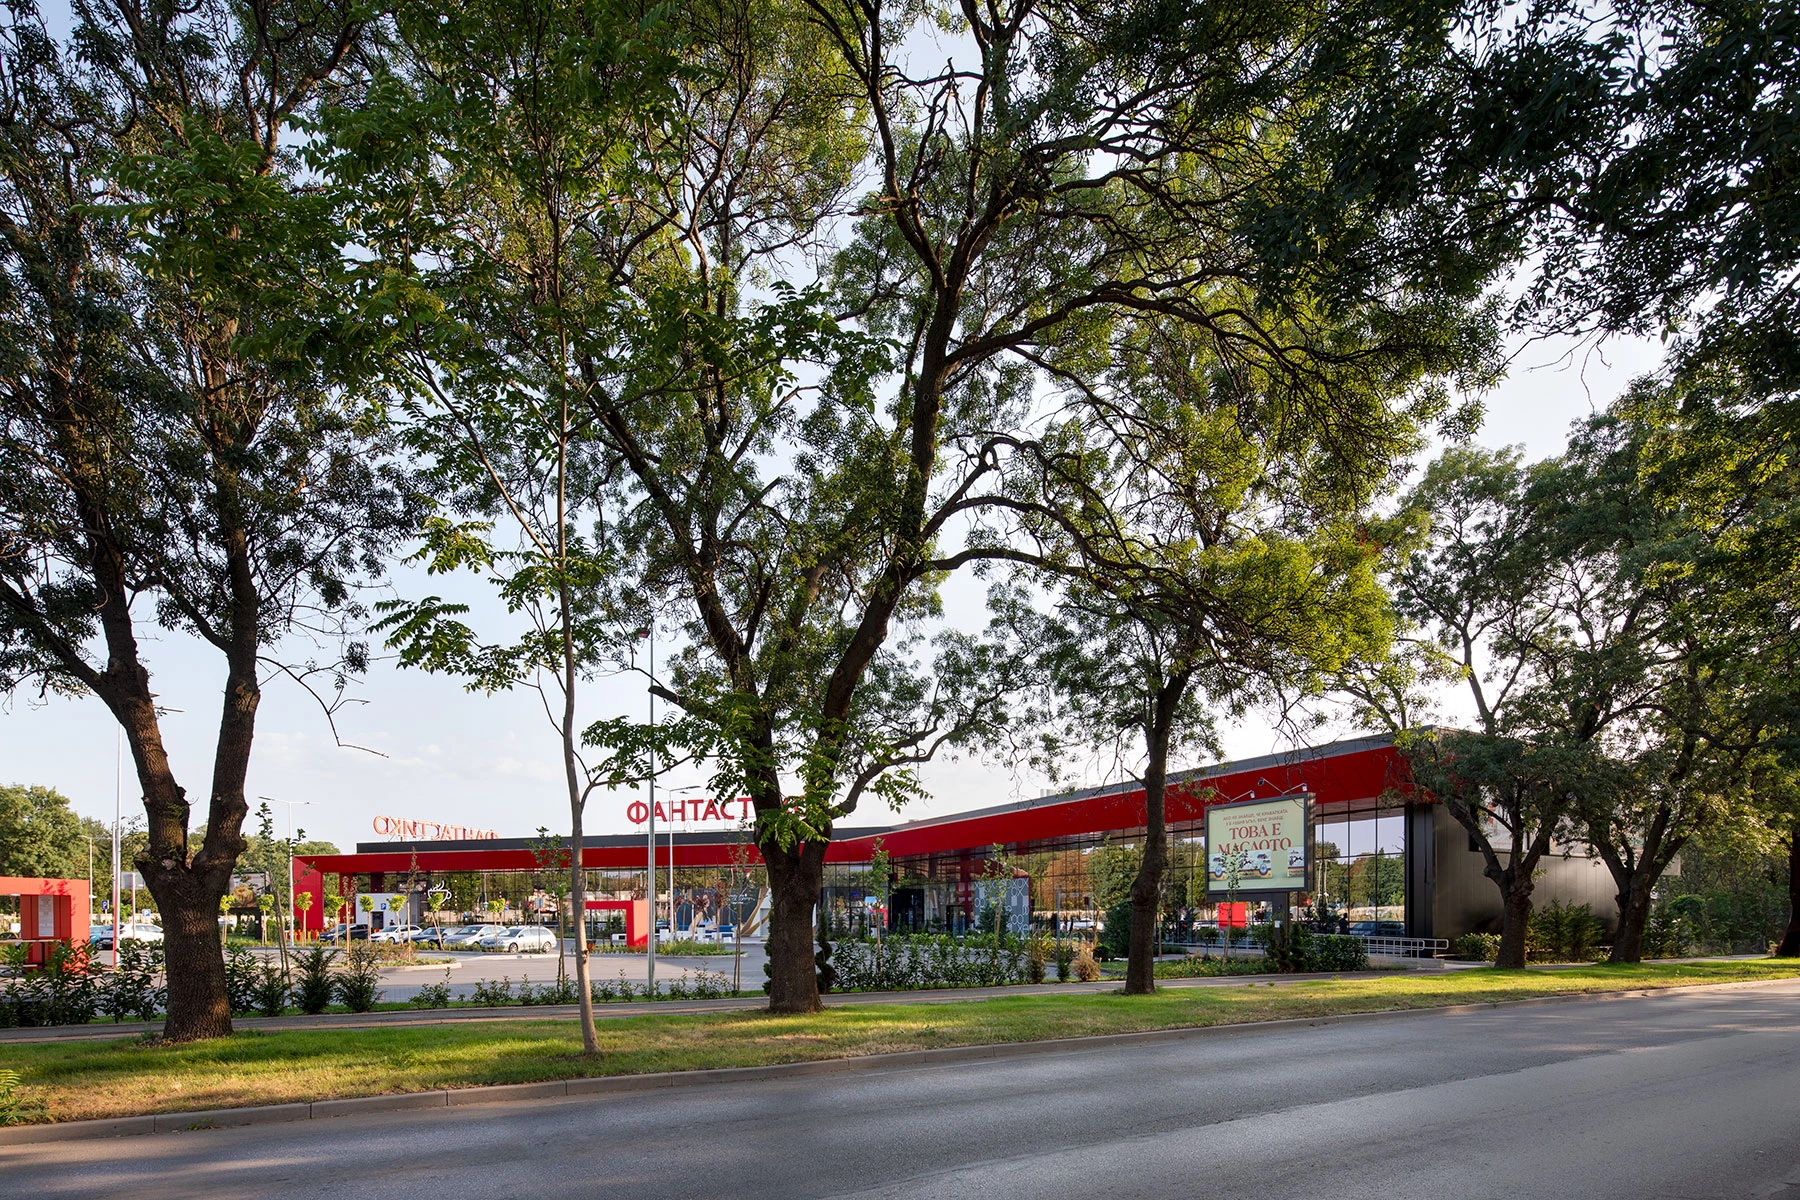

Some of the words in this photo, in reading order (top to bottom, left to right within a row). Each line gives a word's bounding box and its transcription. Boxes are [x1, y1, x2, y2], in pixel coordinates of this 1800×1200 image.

[1229, 825, 1268, 840] ТОВА
[1272, 823, 1281, 836] Е
[1218, 837, 1291, 855] МАСЛОТО
